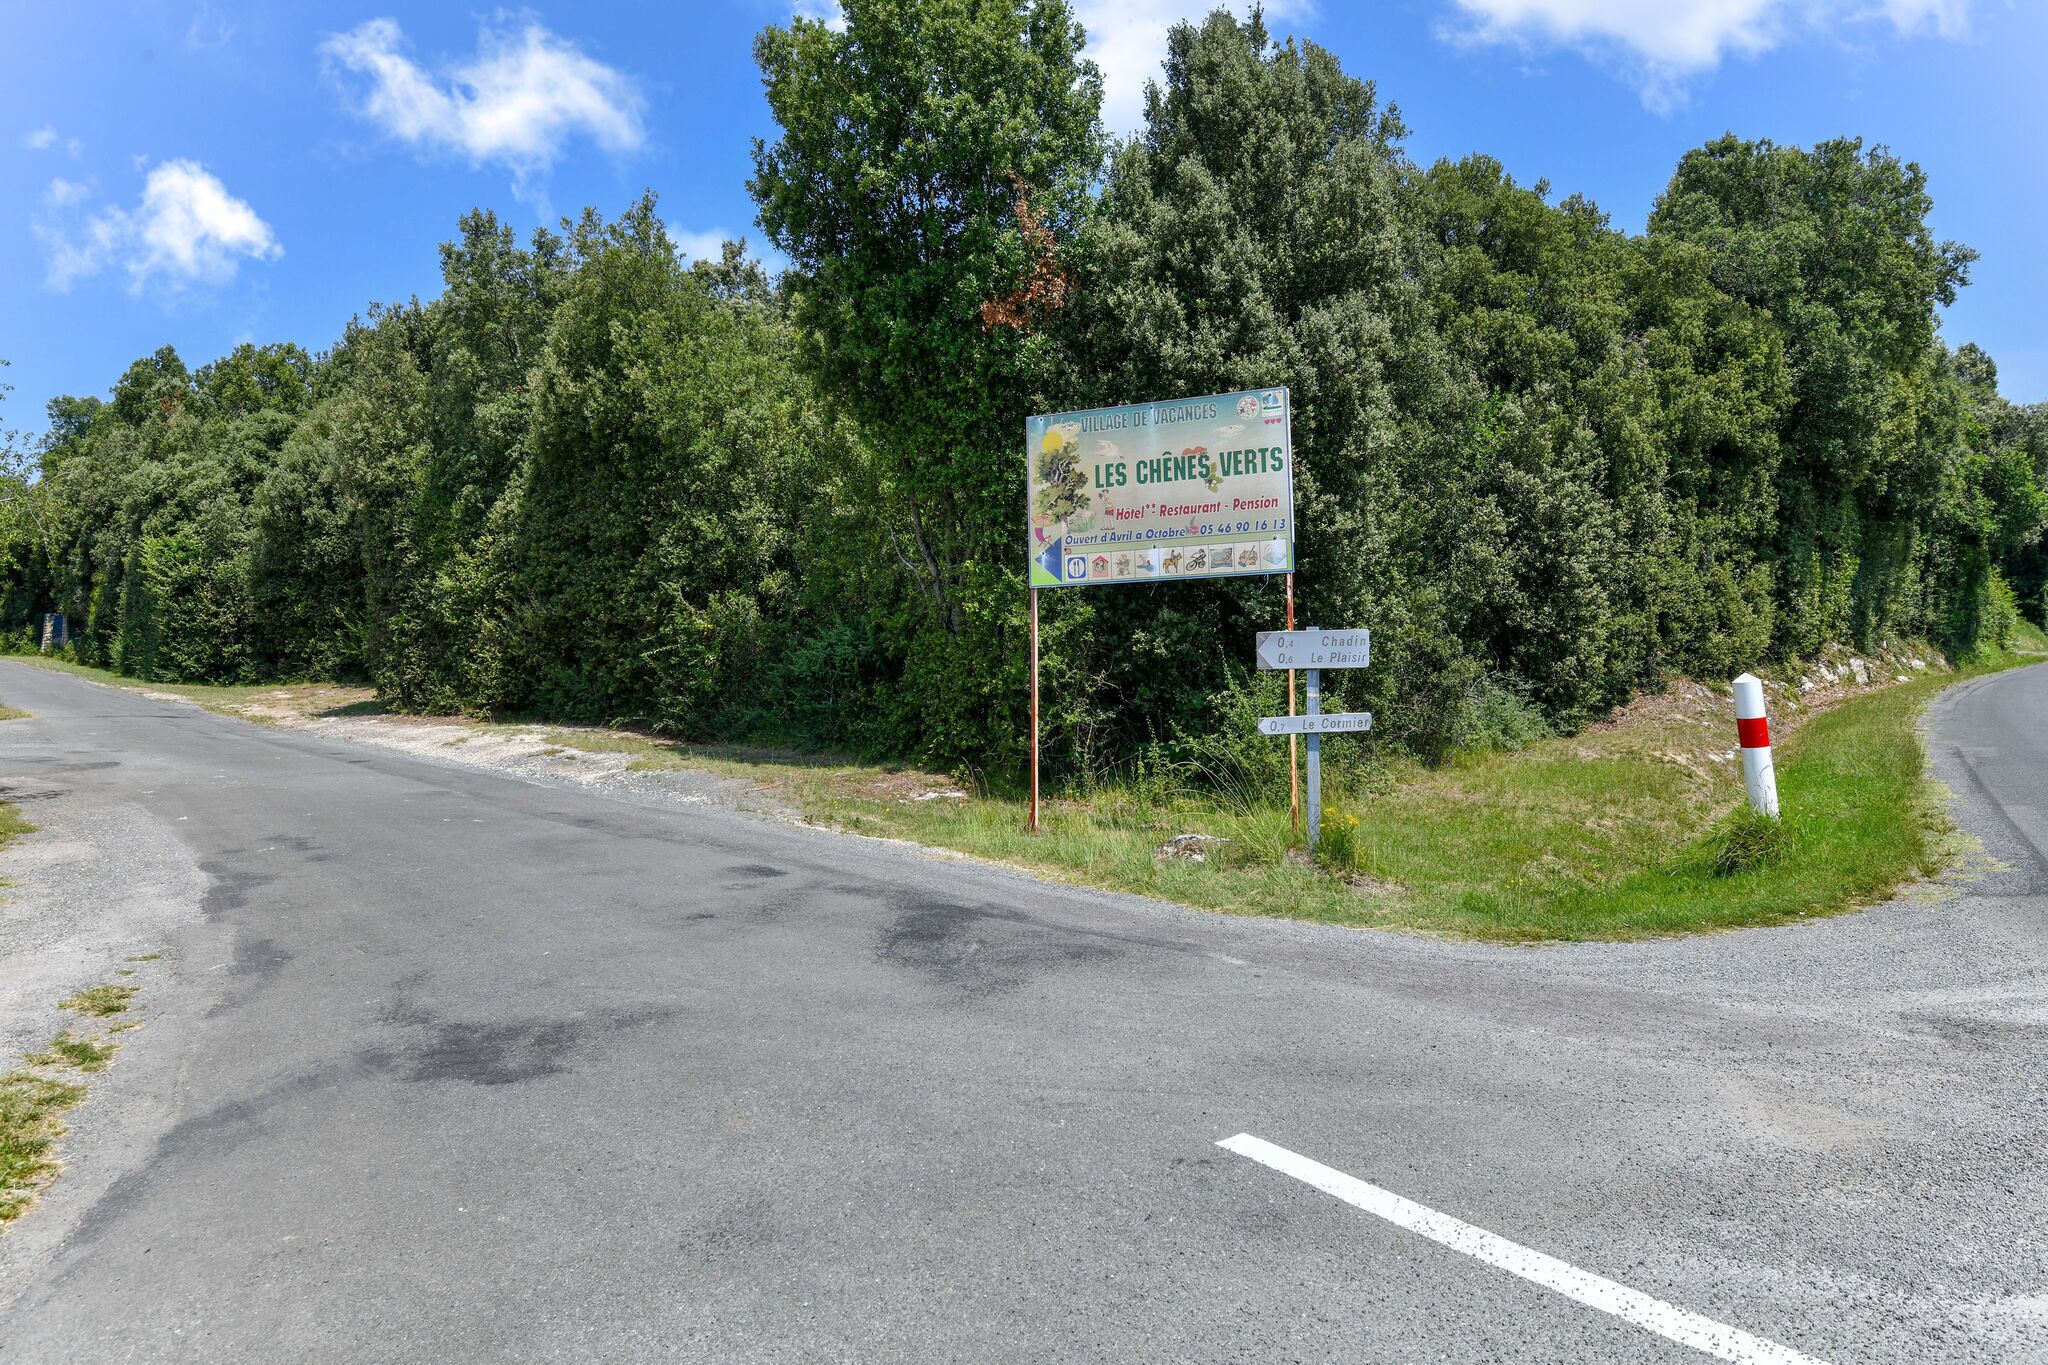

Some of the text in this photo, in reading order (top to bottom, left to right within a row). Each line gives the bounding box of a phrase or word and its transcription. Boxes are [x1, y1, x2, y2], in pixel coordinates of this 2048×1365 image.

[1081, 402, 1217, 433] VILLAGE DE VACANCES
[1095, 447, 1283, 489] LES CHÊNES VERTS
[1159, 501, 1222, 517] Restaurant
[1233, 495, 1278, 511] Pension
[1065, 534, 1098, 545] Ouvert
[1100, 530, 1132, 543] d'Avril
[1146, 527, 1186, 540] Octobre
[1200, 524, 1213, 535] 05
[1217, 522, 1231, 534] 46
[1236, 521, 1250, 532] 90
[1255, 520, 1268, 531] 16
[1273, 518, 1286, 530] 13
[1277, 635, 1366, 649] 0,4 Chadin
[1311, 653, 1323, 663] Le
[1329, 652, 1366, 663] Plaisir
[1269, 717, 1369, 732] 0,7 Le Cormier
